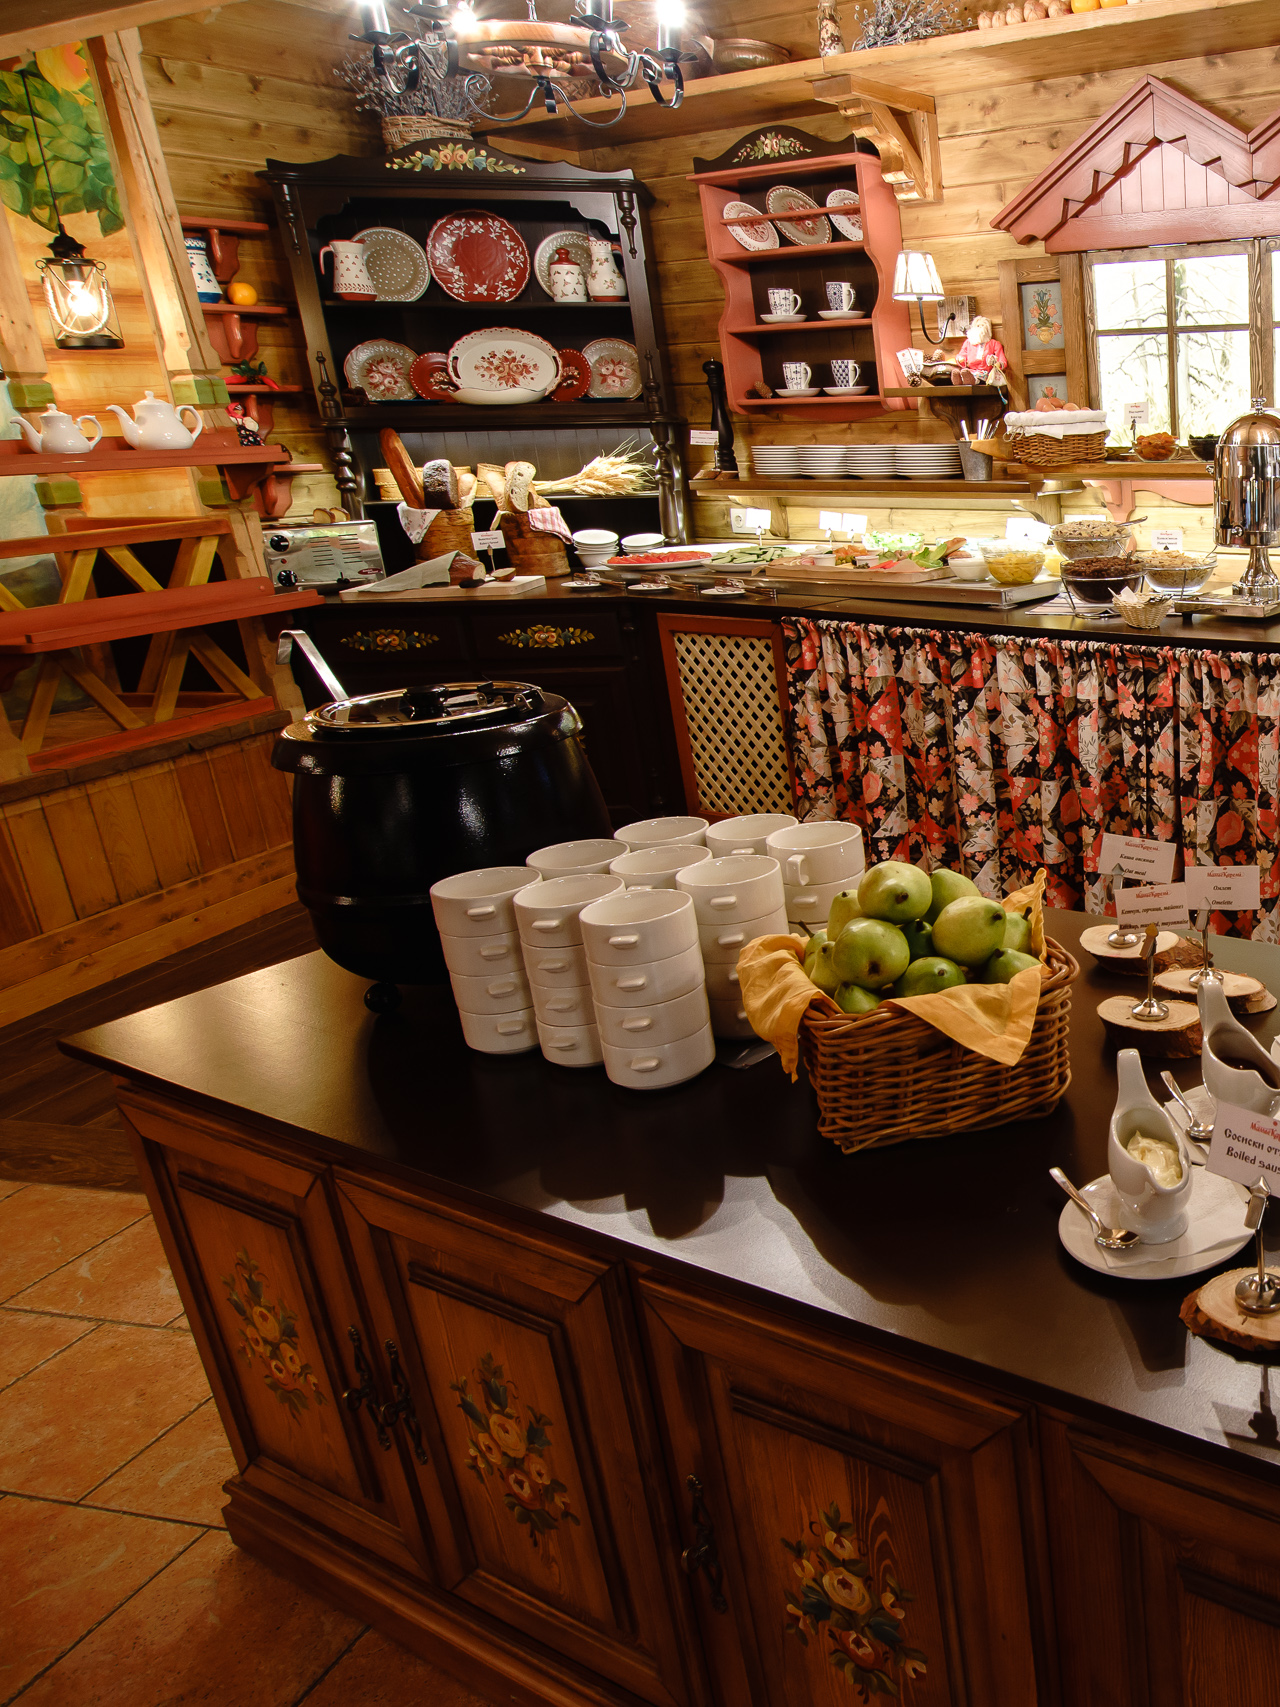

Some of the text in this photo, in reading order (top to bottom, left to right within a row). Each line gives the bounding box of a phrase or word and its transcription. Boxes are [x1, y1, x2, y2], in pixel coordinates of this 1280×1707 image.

[1161, 919, 1189, 927] mayonnaise
[1224, 1128, 1264, 1151] Сосиски
[1226, 1146, 1256, 1165] Boiled
